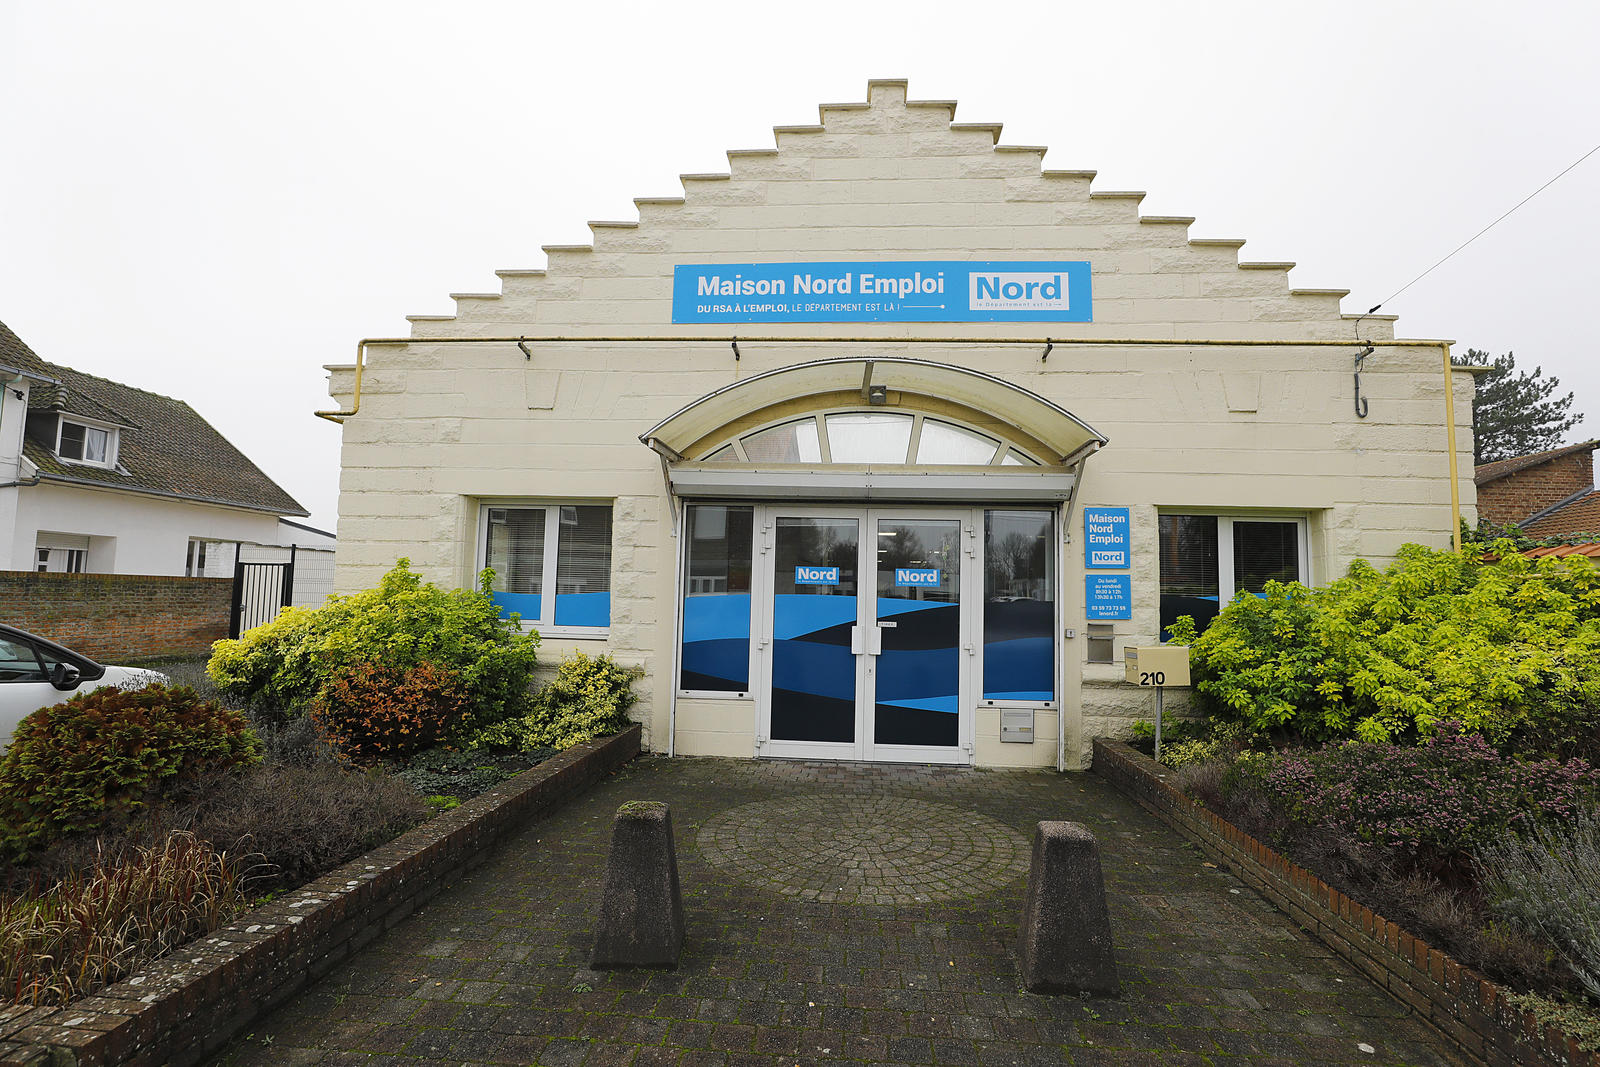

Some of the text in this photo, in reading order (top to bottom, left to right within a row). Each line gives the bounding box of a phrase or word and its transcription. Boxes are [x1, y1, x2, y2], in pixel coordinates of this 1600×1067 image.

[697, 272, 945, 299] Maison Nord Emploi
[976, 275, 1062, 300] Nord
[697, 304, 711, 313] DU
[713, 304, 733, 313] RSA
[734, 302, 741, 313] À
[743, 303, 790, 313] L'EMPLOI,
[792, 303, 802, 312] LE
[805, 302, 862, 312] DÉPARTEMENT
[865, 303, 881, 312] EST
[884, 302, 895, 312] LÀ
[1089, 513, 1126, 523] Maison
[1089, 523, 1113, 533] Nord
[1089, 533, 1124, 546] Emploi
[1094, 552, 1122, 561] Nord
[798, 567, 837, 581] Nord
[898, 569, 938, 583] Nord
[1139, 671, 1165, 686] 210
